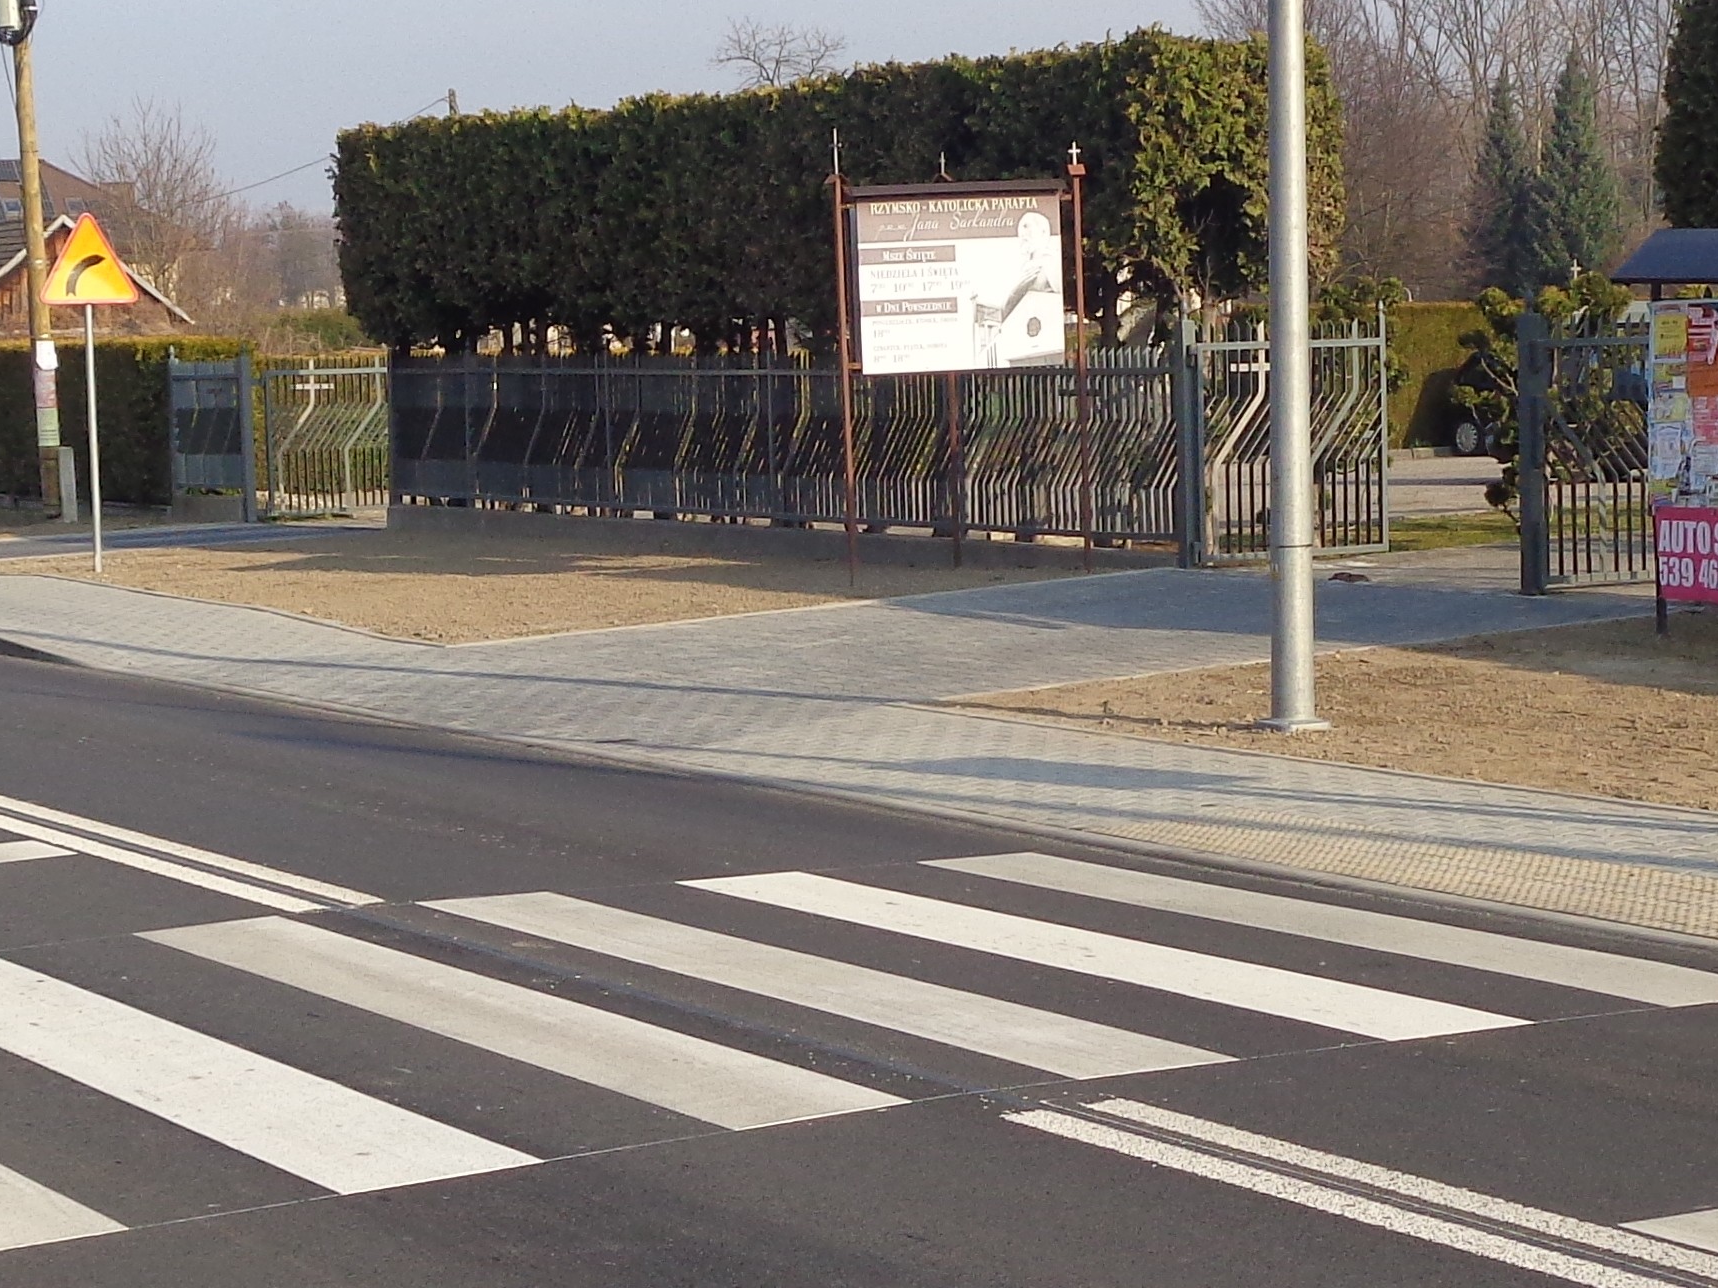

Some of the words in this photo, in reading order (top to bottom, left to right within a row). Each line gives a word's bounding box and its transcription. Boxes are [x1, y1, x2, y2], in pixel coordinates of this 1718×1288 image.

[869, 202, 920, 215] RZYMSKO
[929, 199, 989, 212] KATOLICKA
[992, 197, 1038, 210] PARAFIA
[903, 211, 939, 242] Jana
[949, 209, 1015, 230] Sarkandra
[870, 269, 918, 279] NIEDZIELA
[1658, 520, 1711, 555] AUTO
[1659, 556, 1694, 587] 539
